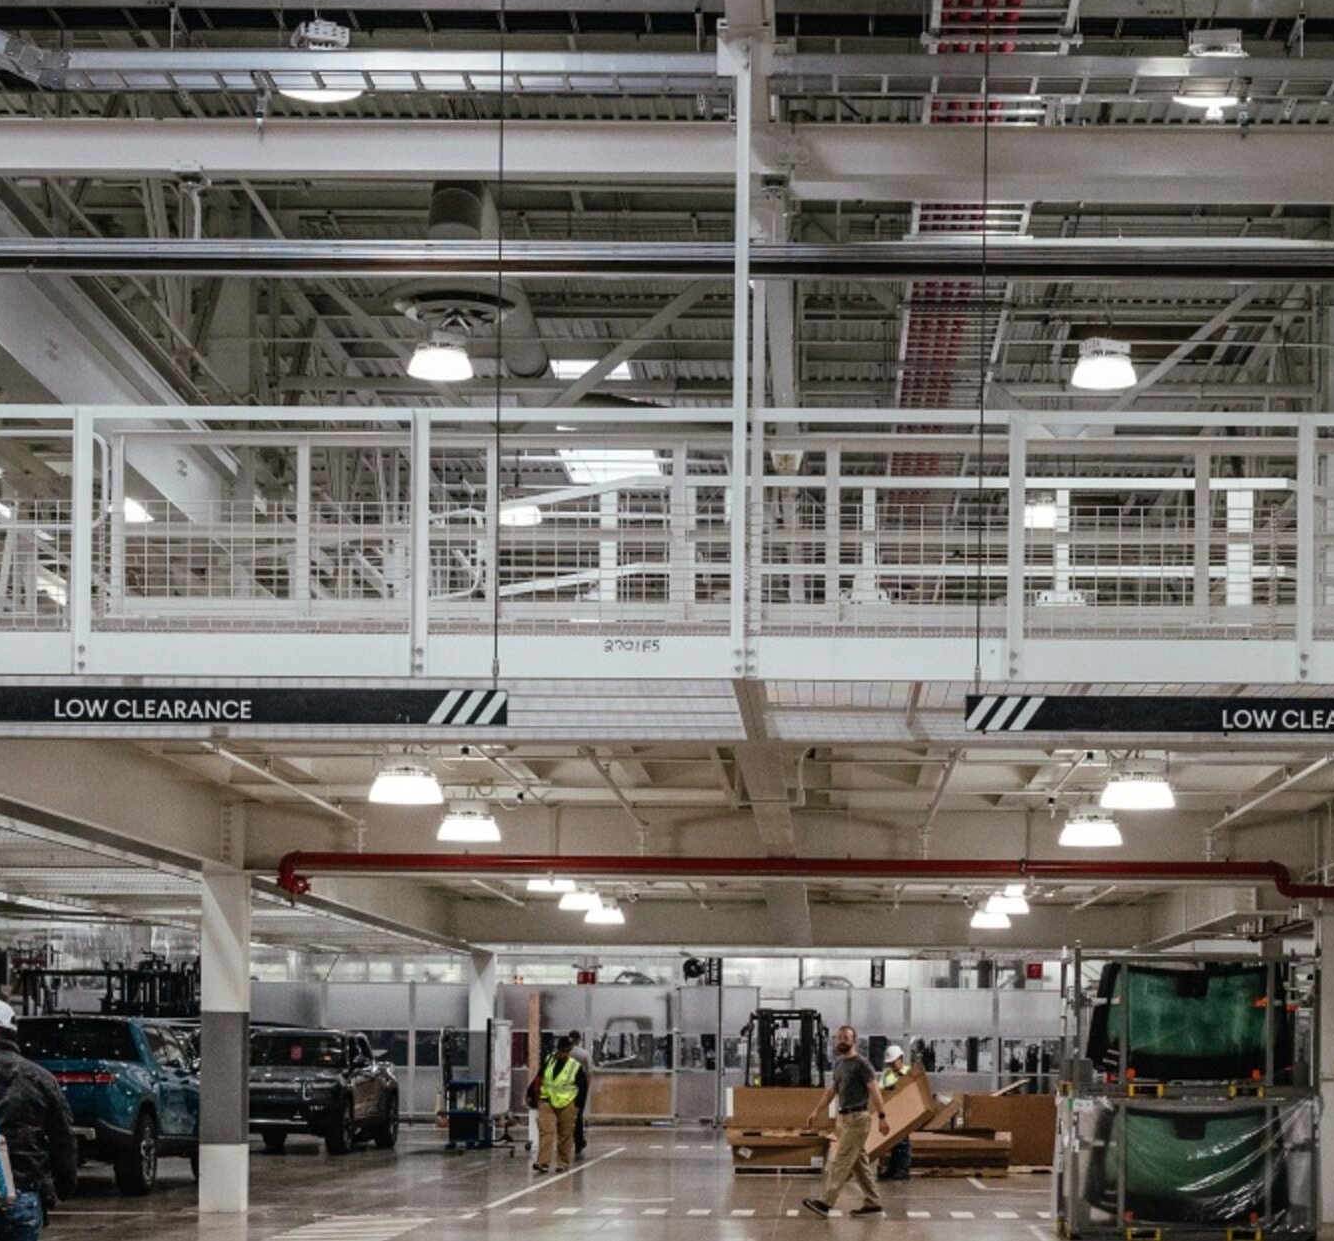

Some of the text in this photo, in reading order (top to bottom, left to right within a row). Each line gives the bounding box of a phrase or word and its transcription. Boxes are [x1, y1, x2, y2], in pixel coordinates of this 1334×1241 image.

[53, 698, 253, 720] LOW CLEARANCE
[1222, 709, 1277, 730] LOW
